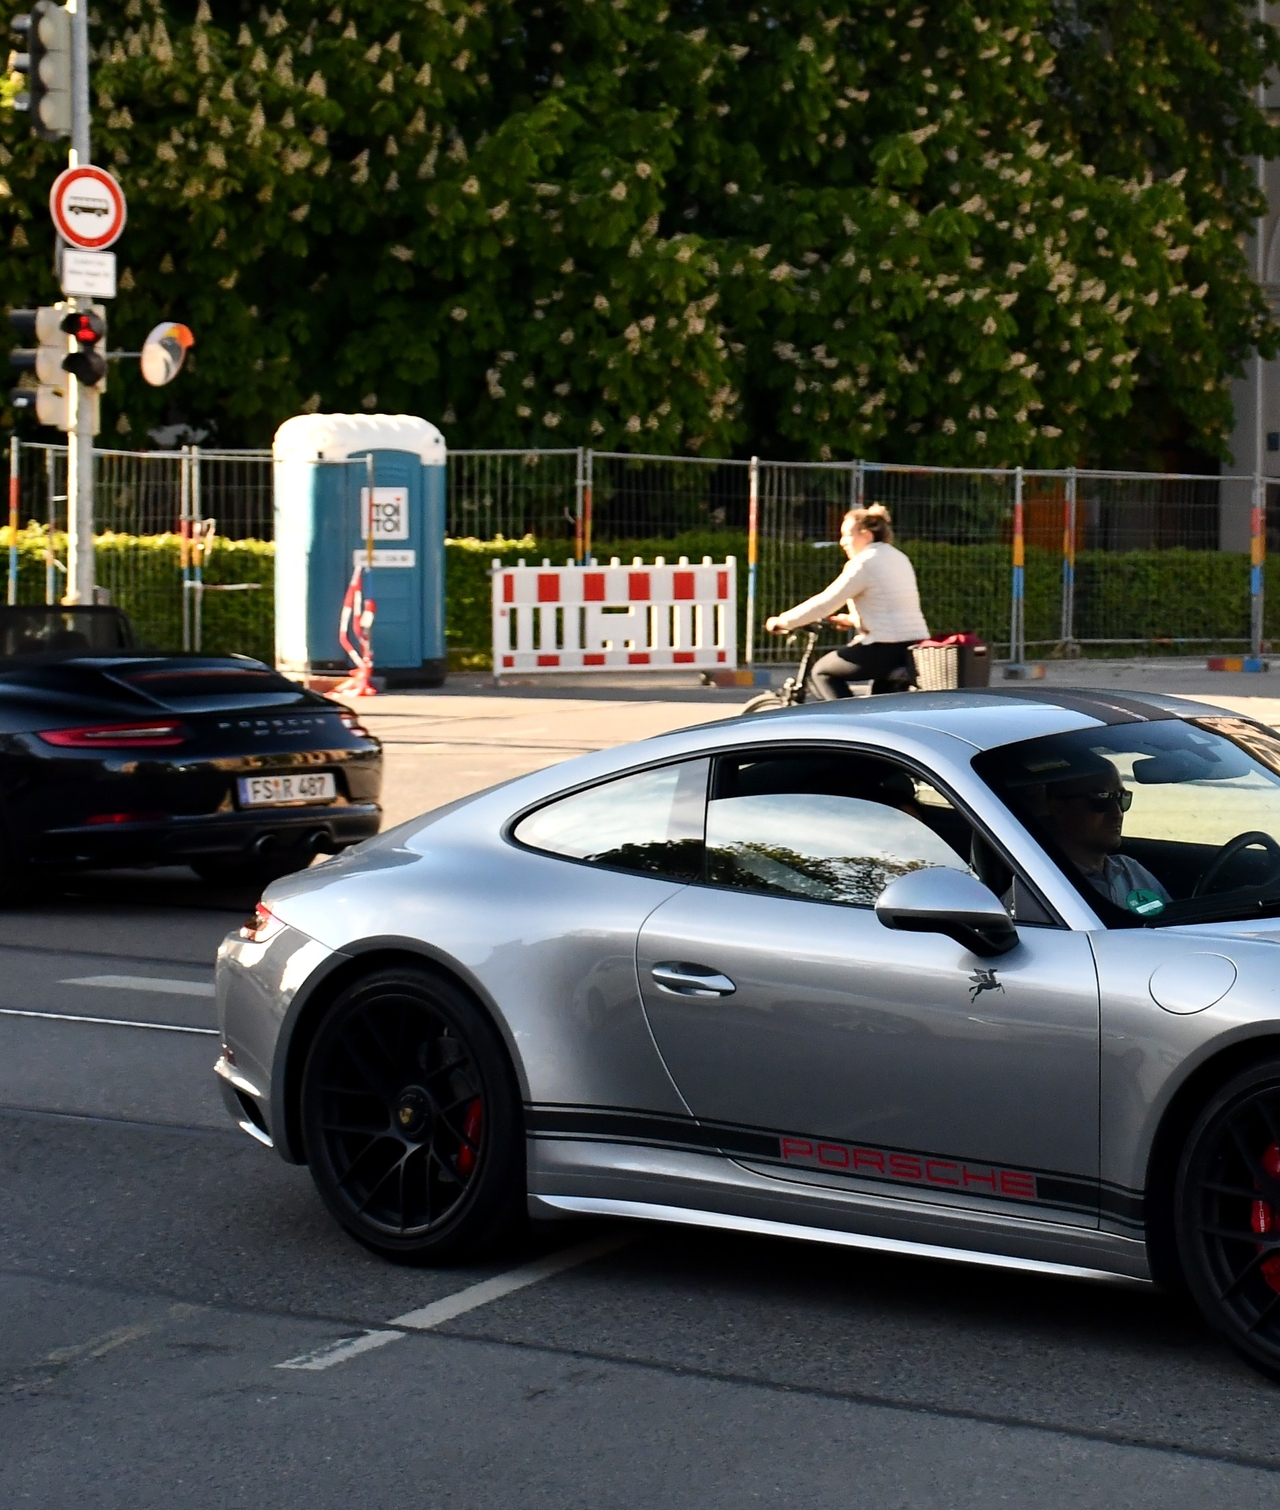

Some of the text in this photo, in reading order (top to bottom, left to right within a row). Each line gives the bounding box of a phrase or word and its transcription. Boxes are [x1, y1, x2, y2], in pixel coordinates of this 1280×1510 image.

[252, 776, 326, 799] FS R 487
[781, 1137, 1036, 1198] PORSCHE
